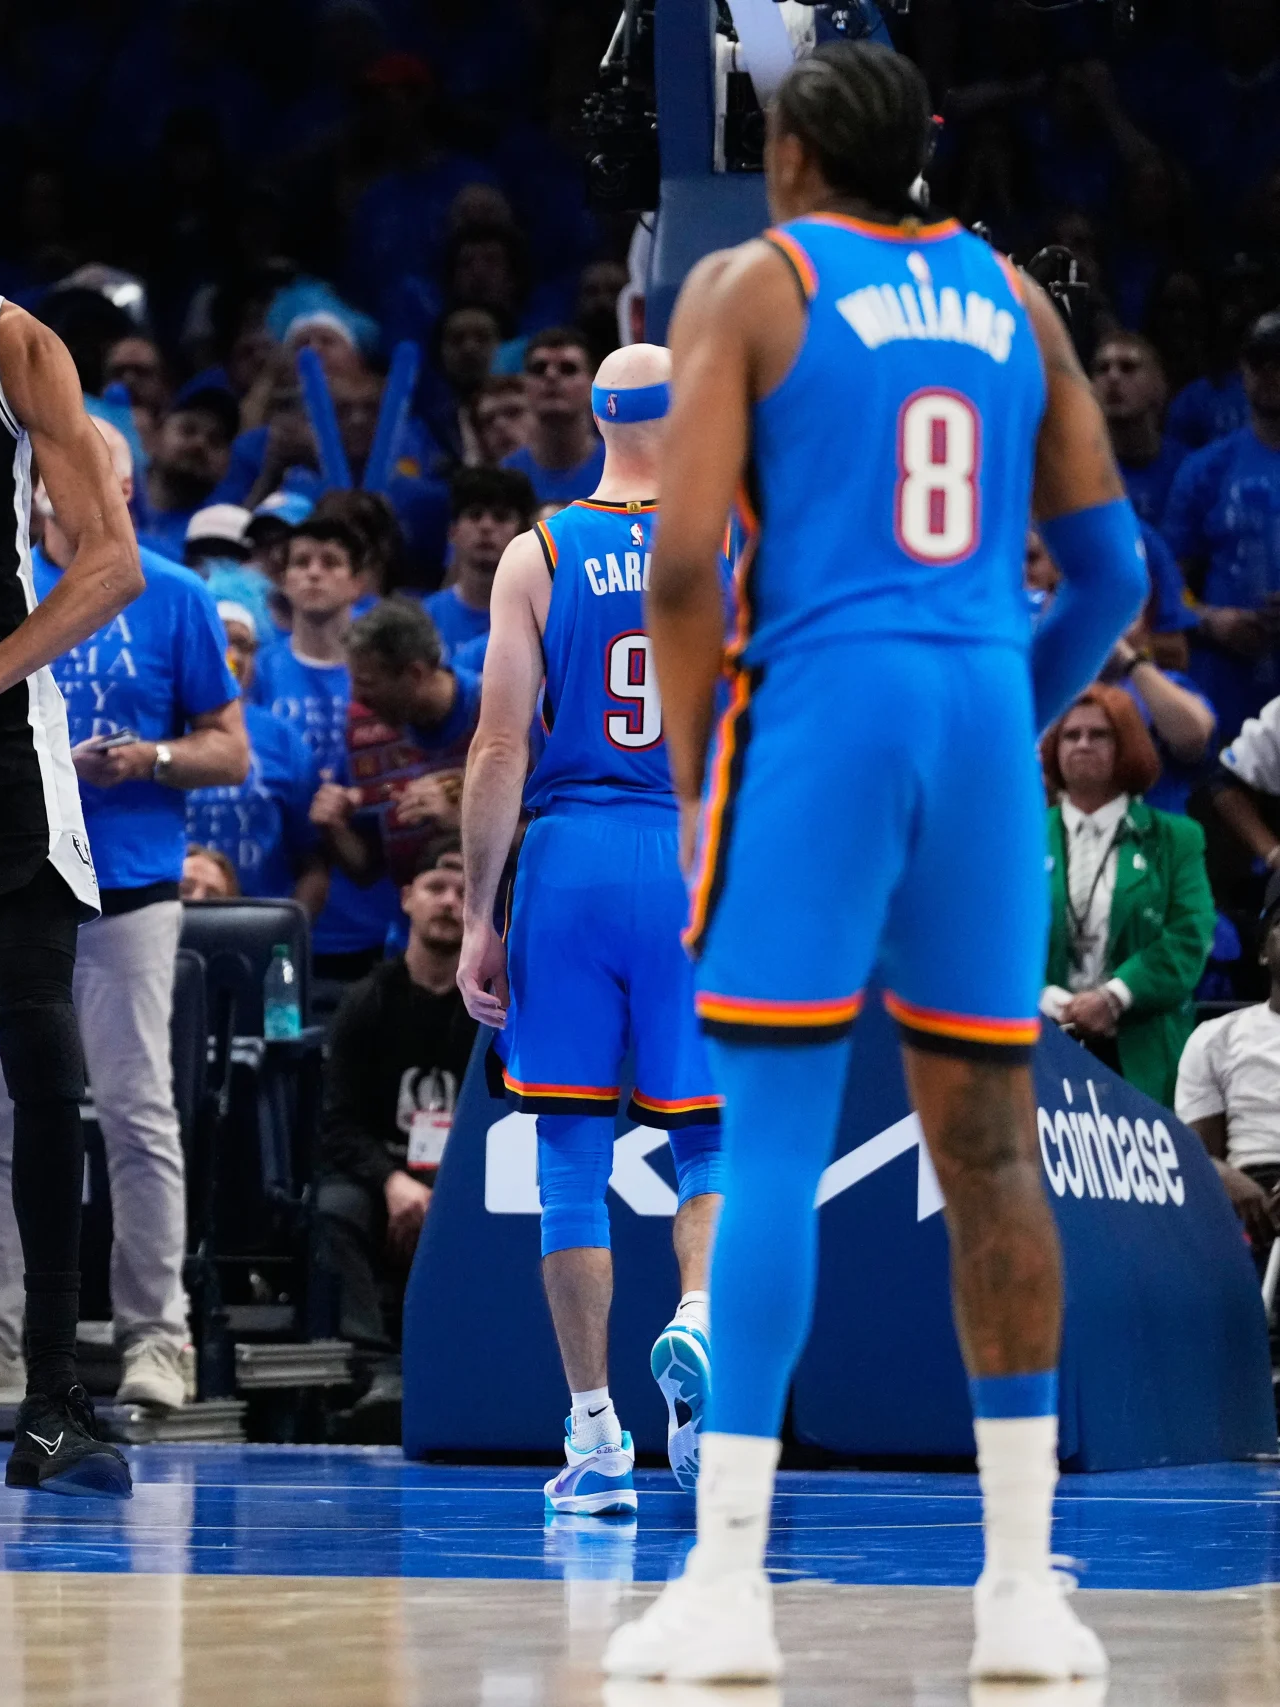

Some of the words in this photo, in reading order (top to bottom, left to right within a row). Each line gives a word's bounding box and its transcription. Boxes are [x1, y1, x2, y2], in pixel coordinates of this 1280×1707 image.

[835, 283, 1017, 364] WILLIAMS
[894, 387, 983, 567] 8
[604, 629, 664, 752] 9
[1037, 1078, 1185, 1207] coinbase
